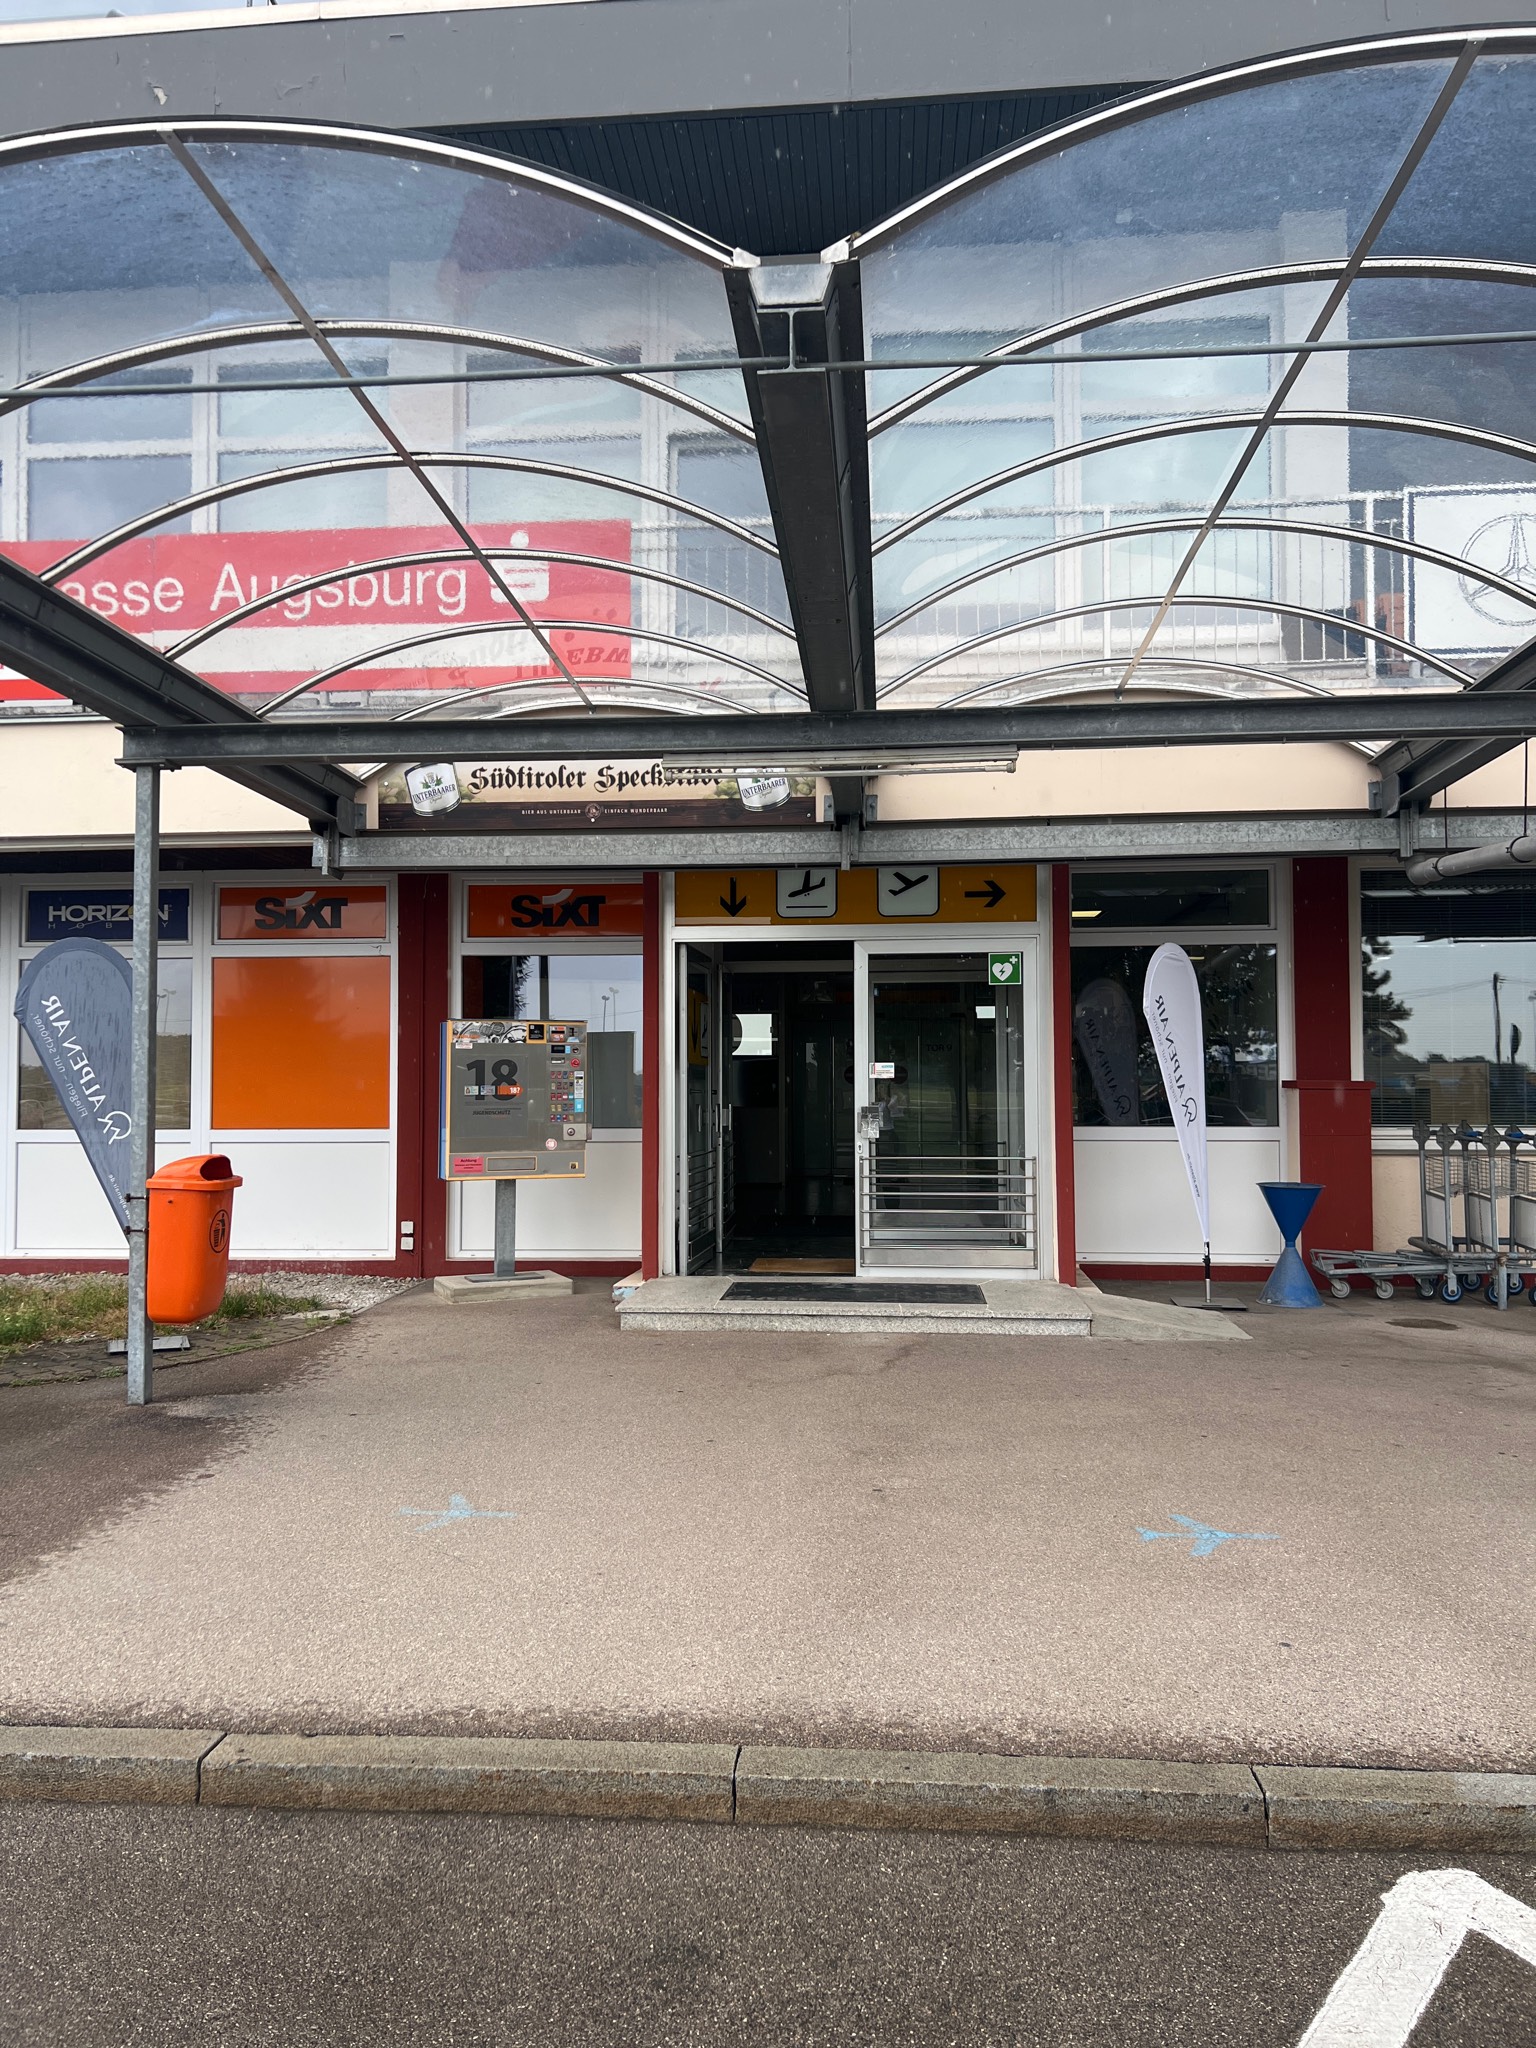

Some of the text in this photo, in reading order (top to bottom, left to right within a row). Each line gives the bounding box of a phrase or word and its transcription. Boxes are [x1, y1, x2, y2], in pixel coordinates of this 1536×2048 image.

[60, 562, 467, 620] asse Augsburg
[467, 764, 586, 794] Südtiroler
[741, 778, 786, 799] UNTERBAARER
[412, 783, 456, 804] UNTERBAARER
[48, 905, 169, 921] HORIZN
[466, 1058, 518, 1101] 18
